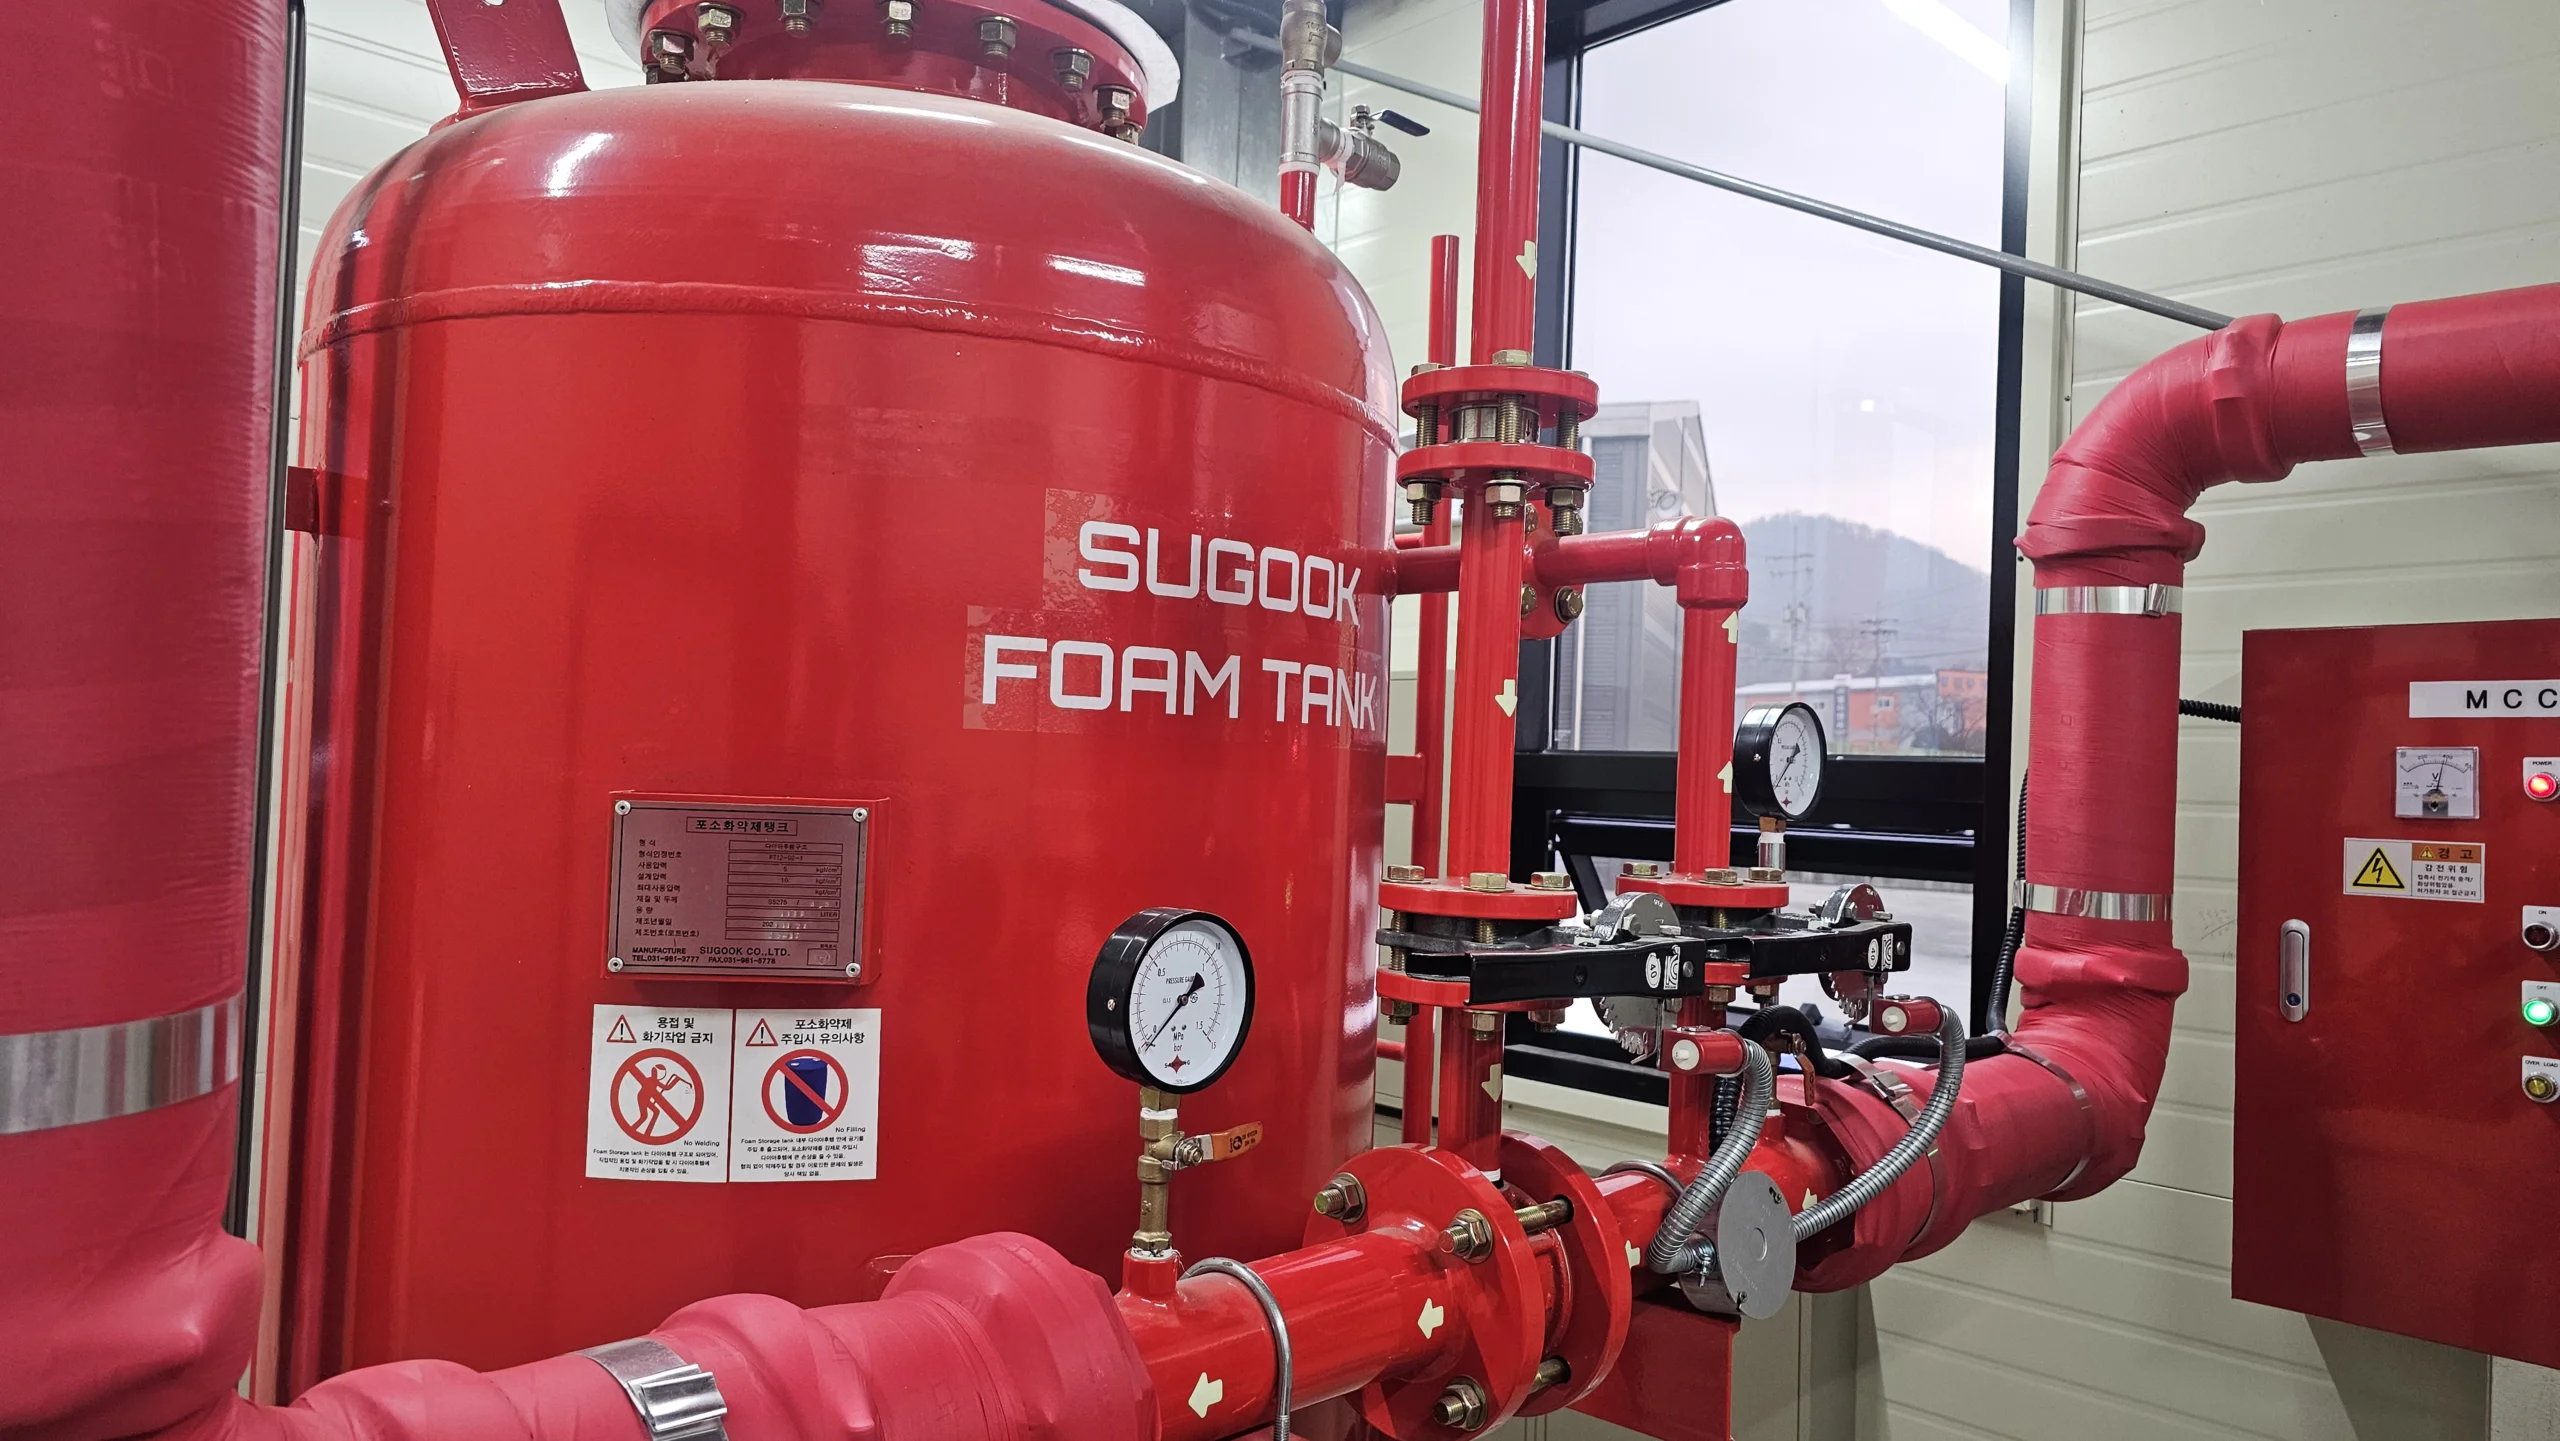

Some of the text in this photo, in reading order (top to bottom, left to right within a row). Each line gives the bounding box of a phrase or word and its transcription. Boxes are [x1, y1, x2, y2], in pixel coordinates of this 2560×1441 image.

[1078, 520, 1362, 627] SUGOOK
[981, 634, 1378, 731] FOAM TANK
[695, 819, 789, 833] 포소화약제탱크
[637, 861, 667, 870] 사용압력
[637, 872, 667, 881] 설계압력
[636, 884, 681, 893] 최대사용압력
[654, 895, 661, 903] 및
[631, 946, 687, 955] MANUFACTURE
[699, 946, 743, 956] SUGOOK
[1871, 947, 1876, 961] 40
[1157, 967, 1166, 977] 0.5
[1650, 963, 1657, 979] 40
[1165, 976, 1185, 985] PRESSURE
[656, 1016, 695, 1029] 용접 및
[794, 1018, 852, 1030] 포소화약제
[642, 1031, 713, 1044] 화기작업 금지
[780, 1032, 865, 1045] 주입시 유의사항
[1172, 1031, 1184, 1041] MPa
[1173, 1043, 1183, 1052] bar
